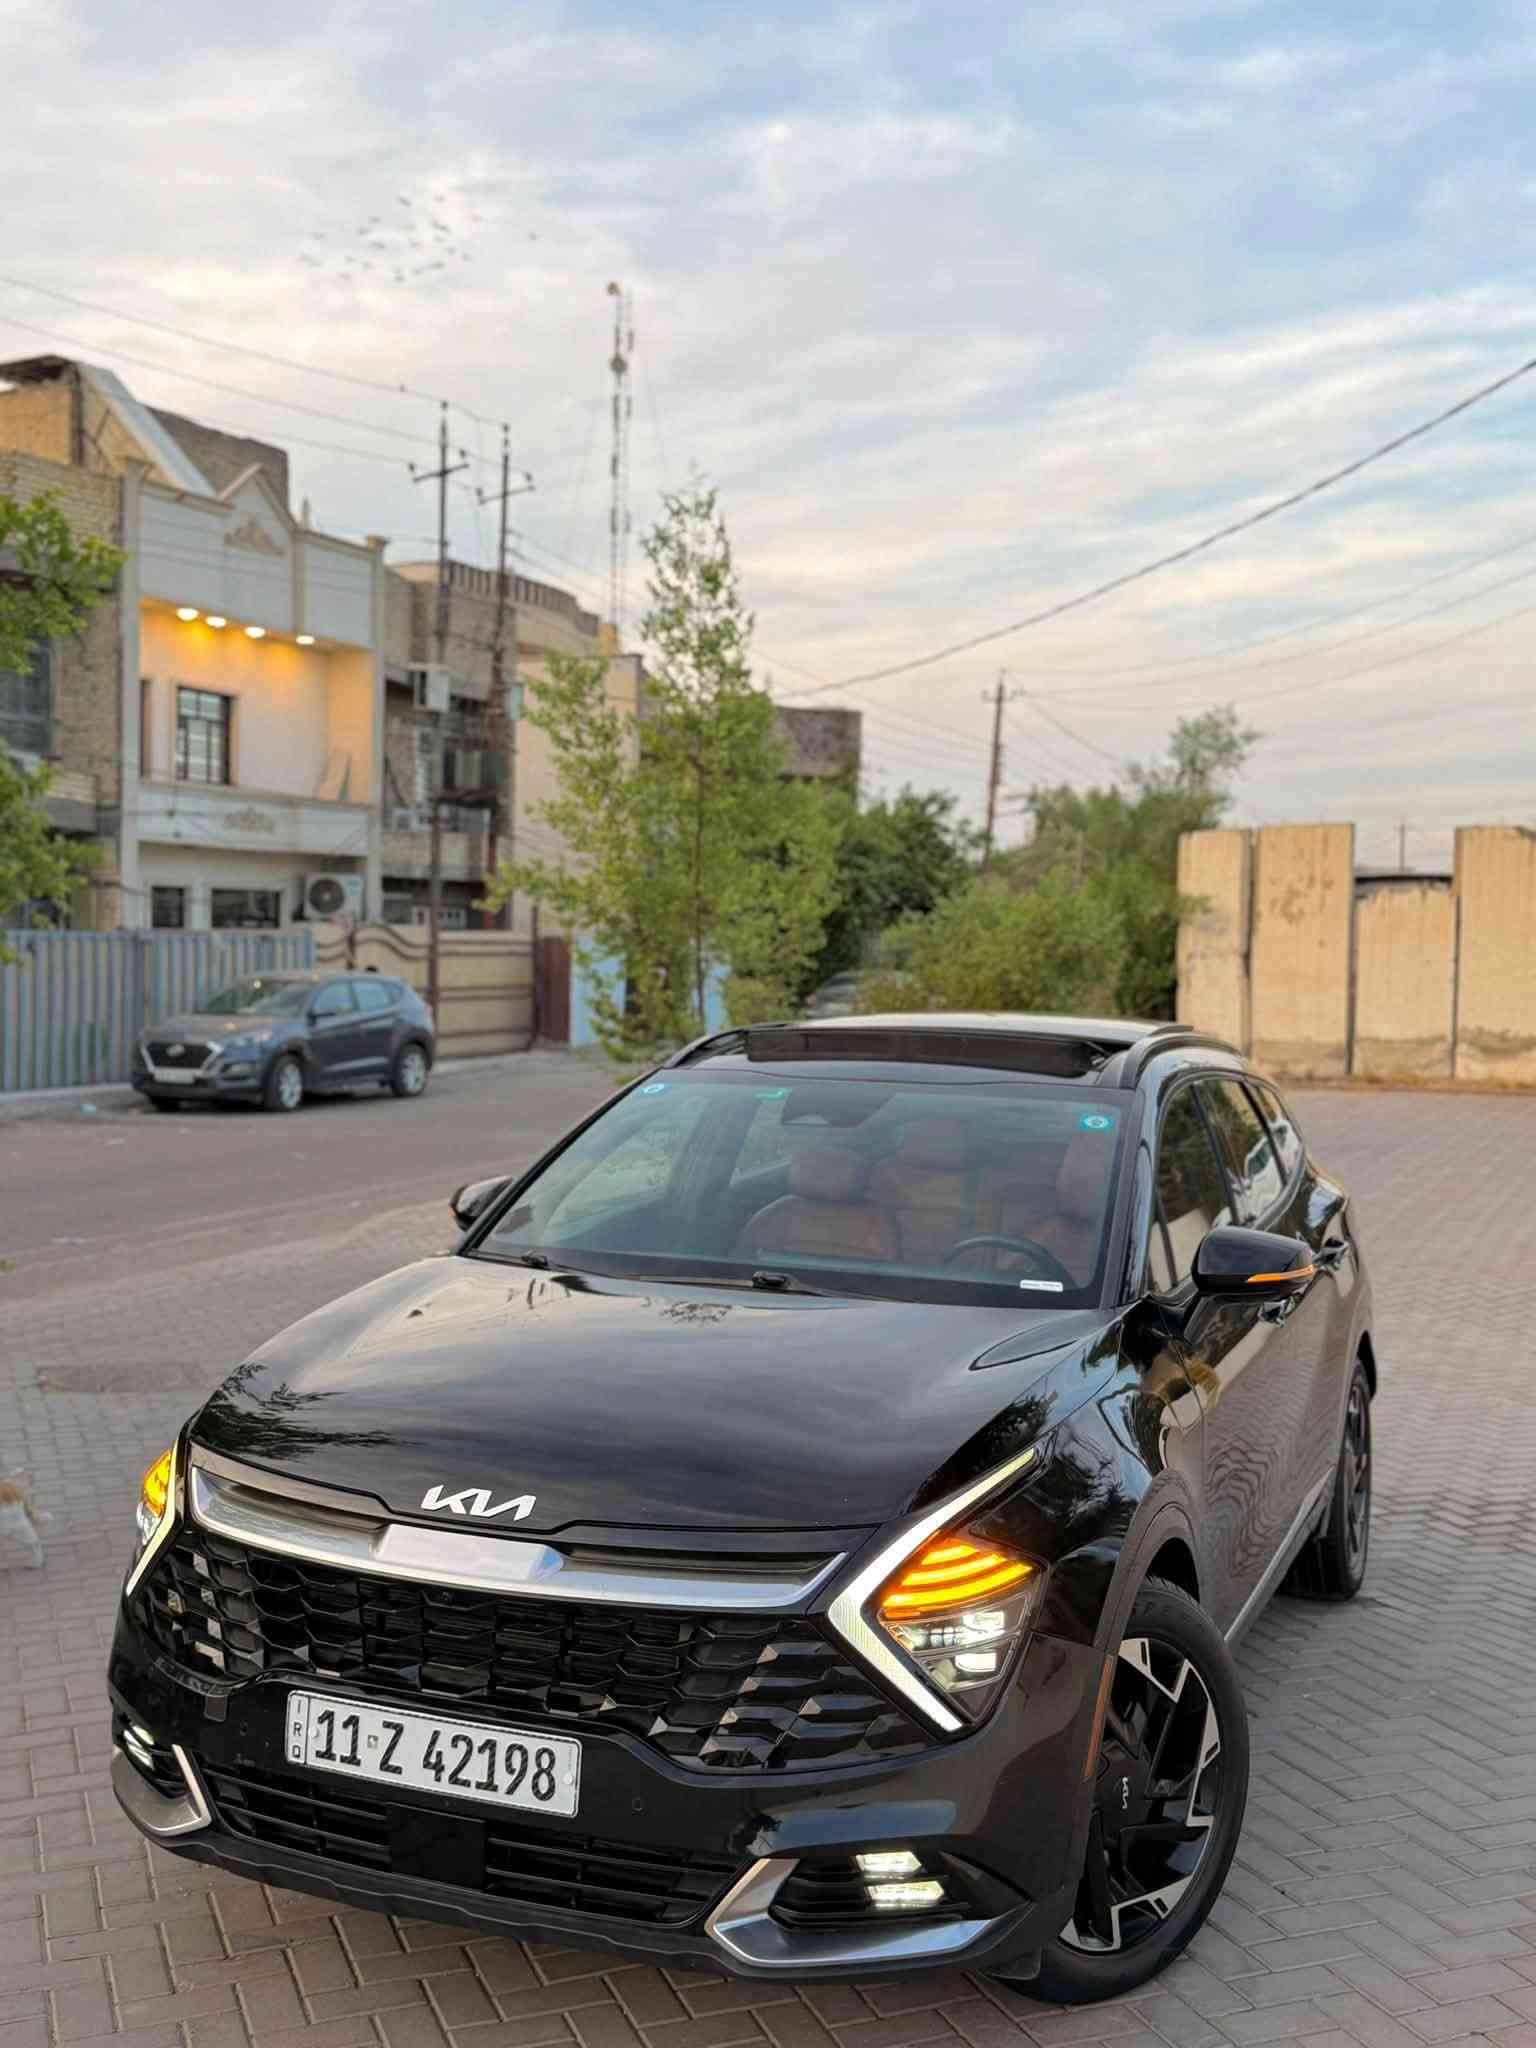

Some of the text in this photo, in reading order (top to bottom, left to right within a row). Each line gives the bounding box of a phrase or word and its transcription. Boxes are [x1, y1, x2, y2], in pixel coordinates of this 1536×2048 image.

[421, 1485, 537, 1521] KIA
[315, 1709, 361, 1767] 11
[379, 1720, 404, 1775] Z
[422, 1729, 556, 1801] 42198
